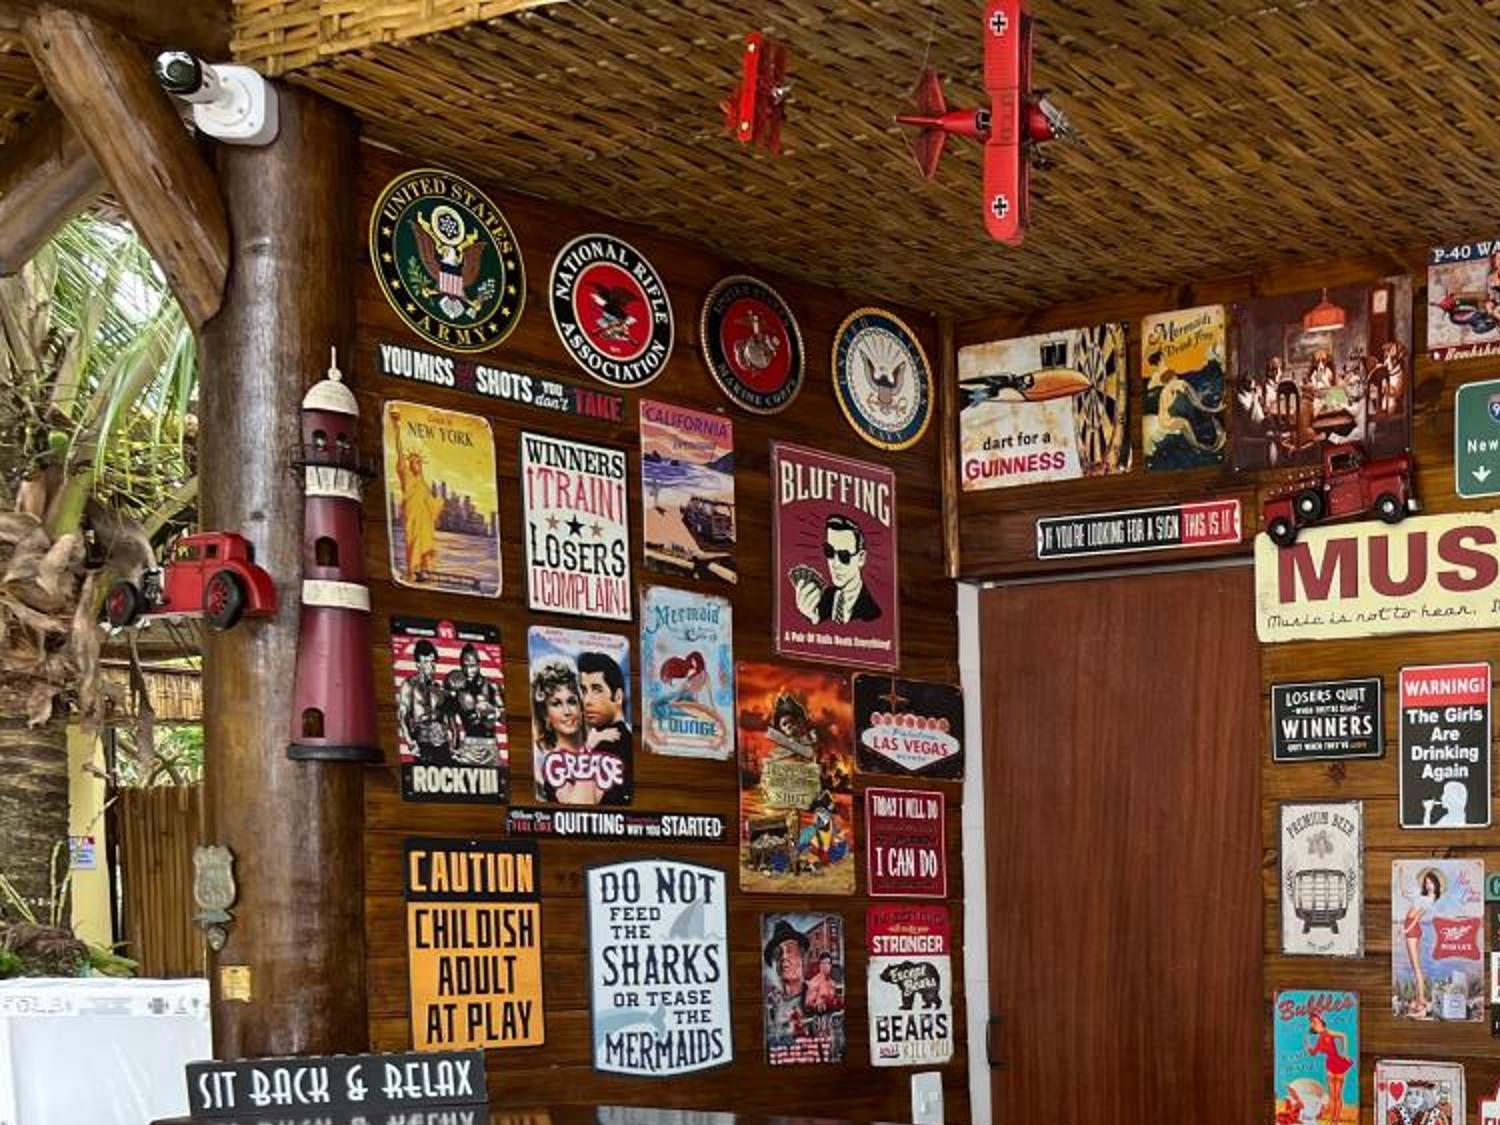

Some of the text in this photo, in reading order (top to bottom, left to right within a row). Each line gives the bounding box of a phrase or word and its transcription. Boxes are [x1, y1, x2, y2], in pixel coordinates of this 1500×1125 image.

[981, 432, 1051, 452] dart for a
[1466, 436, 1499, 453] New
[525, 437, 625, 479] WINNERS
[965, 453, 1065, 480] GUINNESS
[780, 462, 890, 528] BLUFFING
[529, 522, 626, 578] LOSERS
[1286, 688, 1366, 707] LOSERS QUIT
[1405, 677, 1485, 698] WARNING!
[1281, 714, 1372, 739] WINNERS
[1407, 706, 1483, 725] The Girls
[1431, 727, 1460, 742] Are
[1411, 745, 1479, 767] Drinking
[1421, 764, 1470, 785] Again
[410, 851, 534, 893] CAUTION
[601, 871, 716, 904] DO NOT
[610, 907, 661, 922] FEED
[415, 909, 534, 950] CHILDISH
[611, 925, 650, 939] THE
[438, 955, 515, 996] ADULT
[603, 944, 720, 986] SHARKS
[613, 990, 712, 1006] OR TEASE
[427, 1001, 532, 1043] AT PLAY
[674, 1009, 711, 1024] THE
[606, 1027, 723, 1069] MERMAIDS
[199, 1060, 473, 1109] SIT BACK & RELAX
